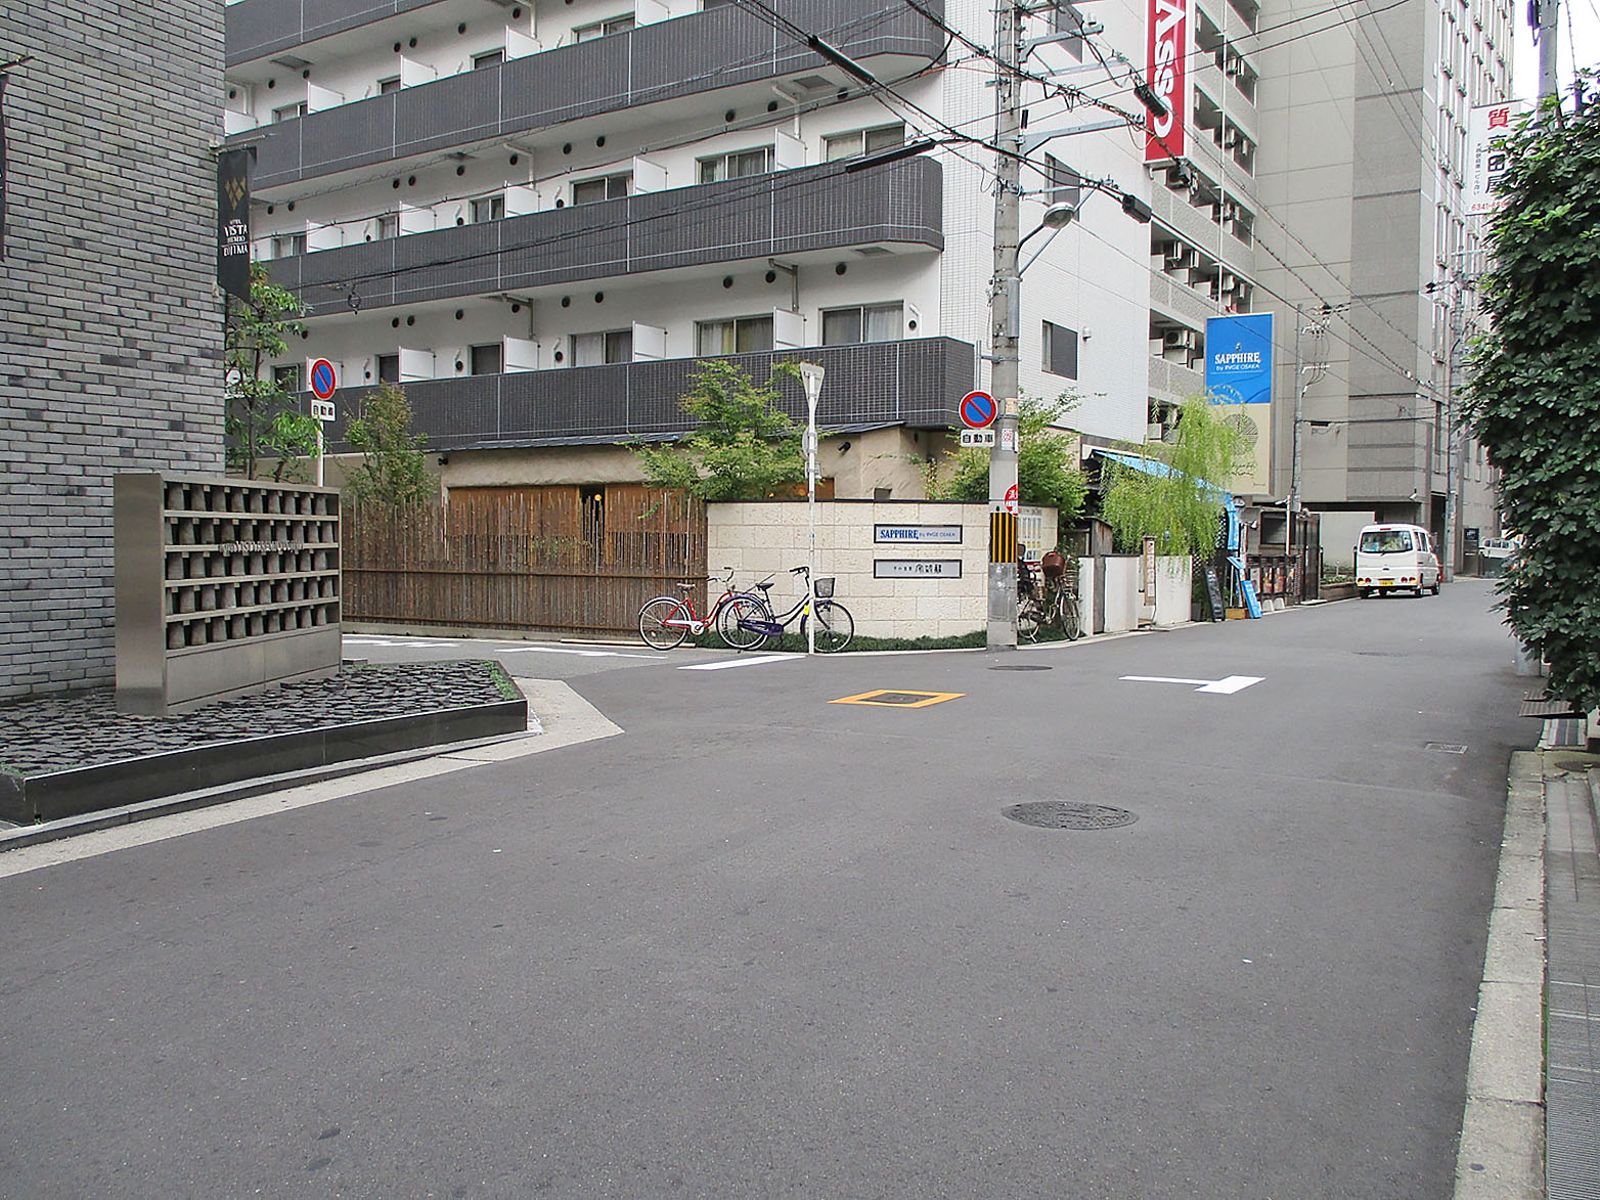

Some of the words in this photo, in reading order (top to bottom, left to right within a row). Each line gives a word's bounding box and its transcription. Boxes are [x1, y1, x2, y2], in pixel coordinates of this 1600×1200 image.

[1488, 107, 1509, 130] 質
[224, 225, 248, 237] VISTA
[1214, 352, 1261, 365] SAPPHIRE
[962, 433, 994, 444] 自動車
[880, 529, 919, 540] SAPPHIRE
